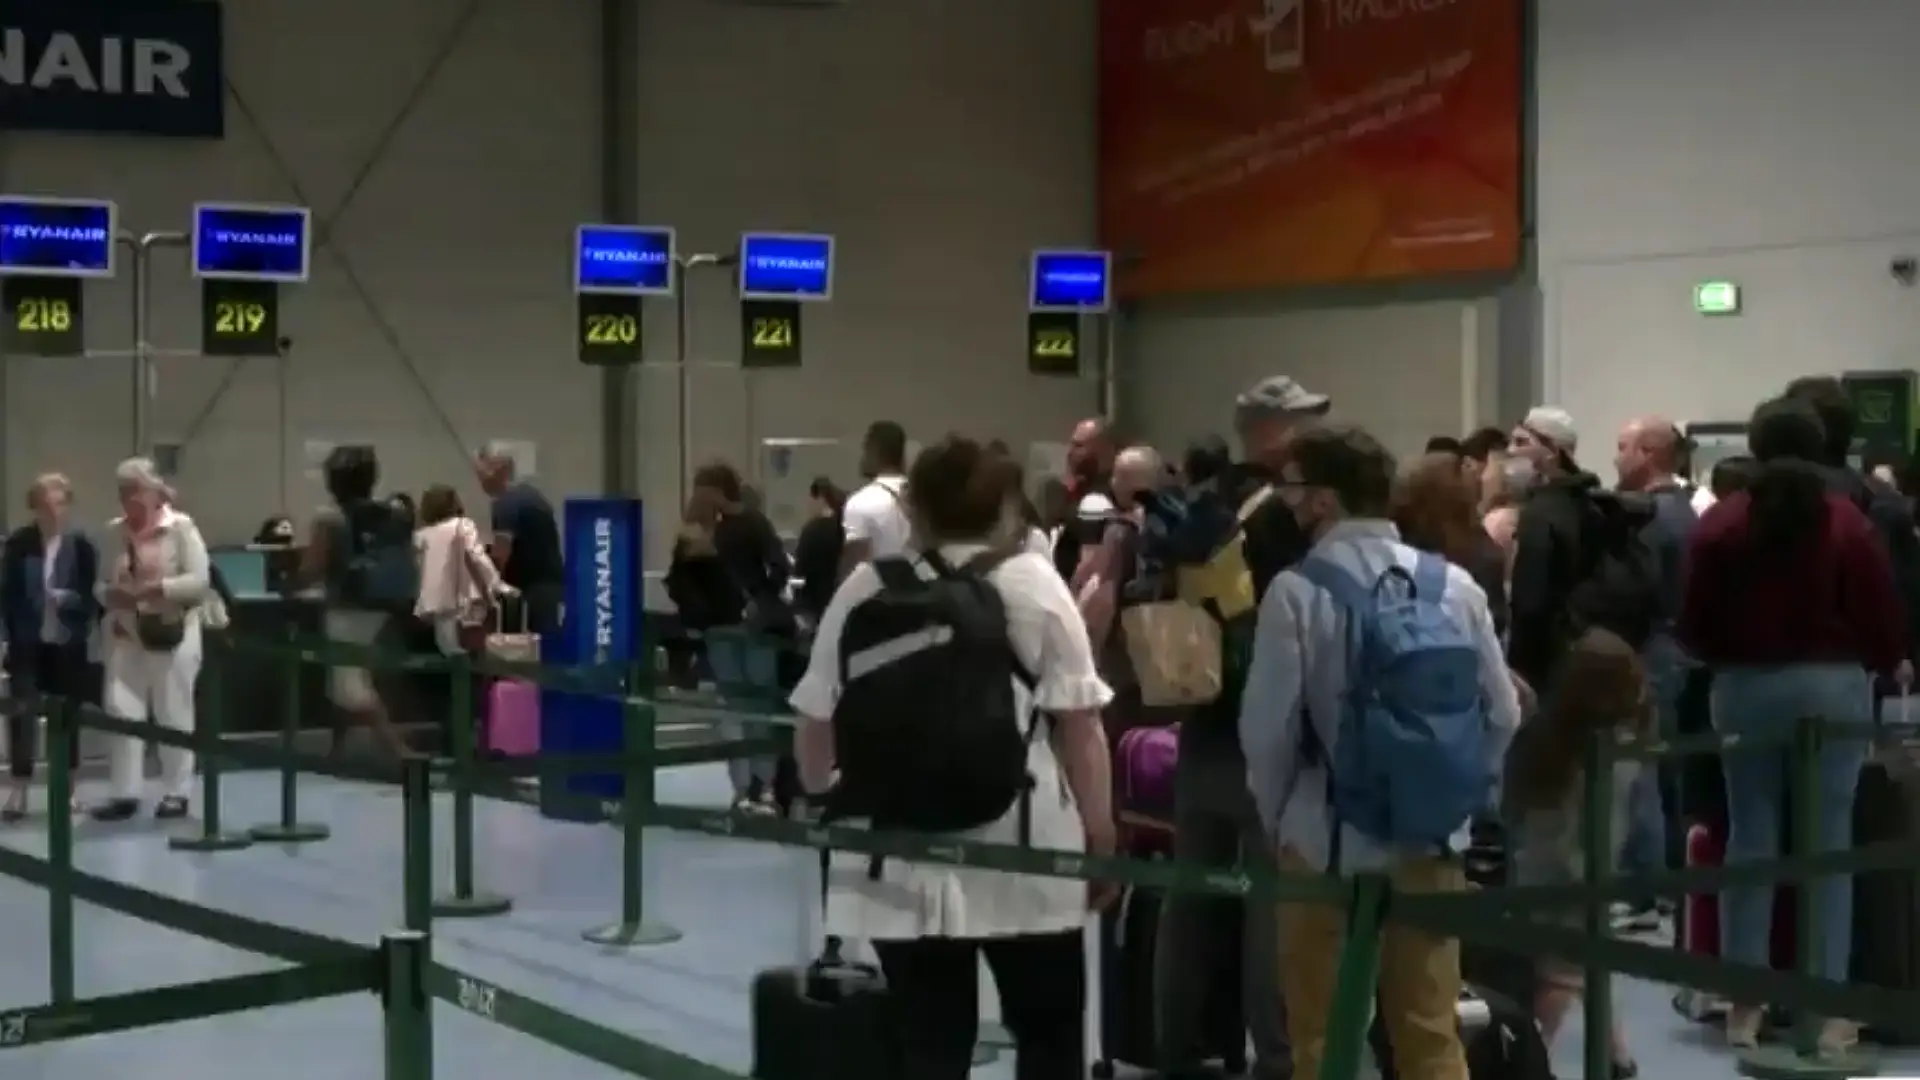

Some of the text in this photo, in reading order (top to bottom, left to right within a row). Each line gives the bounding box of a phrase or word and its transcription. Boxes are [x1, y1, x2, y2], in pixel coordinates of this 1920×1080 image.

[1321, 0, 1457, 30] TRAC
[13, 223, 107, 242] RYANAIR
[17, 299, 71, 331] 218
[215, 303, 265, 333] 219
[586, 314, 638, 343] 220
[753, 319, 792, 346] 221
[594, 517, 612, 646] RYANAIR
